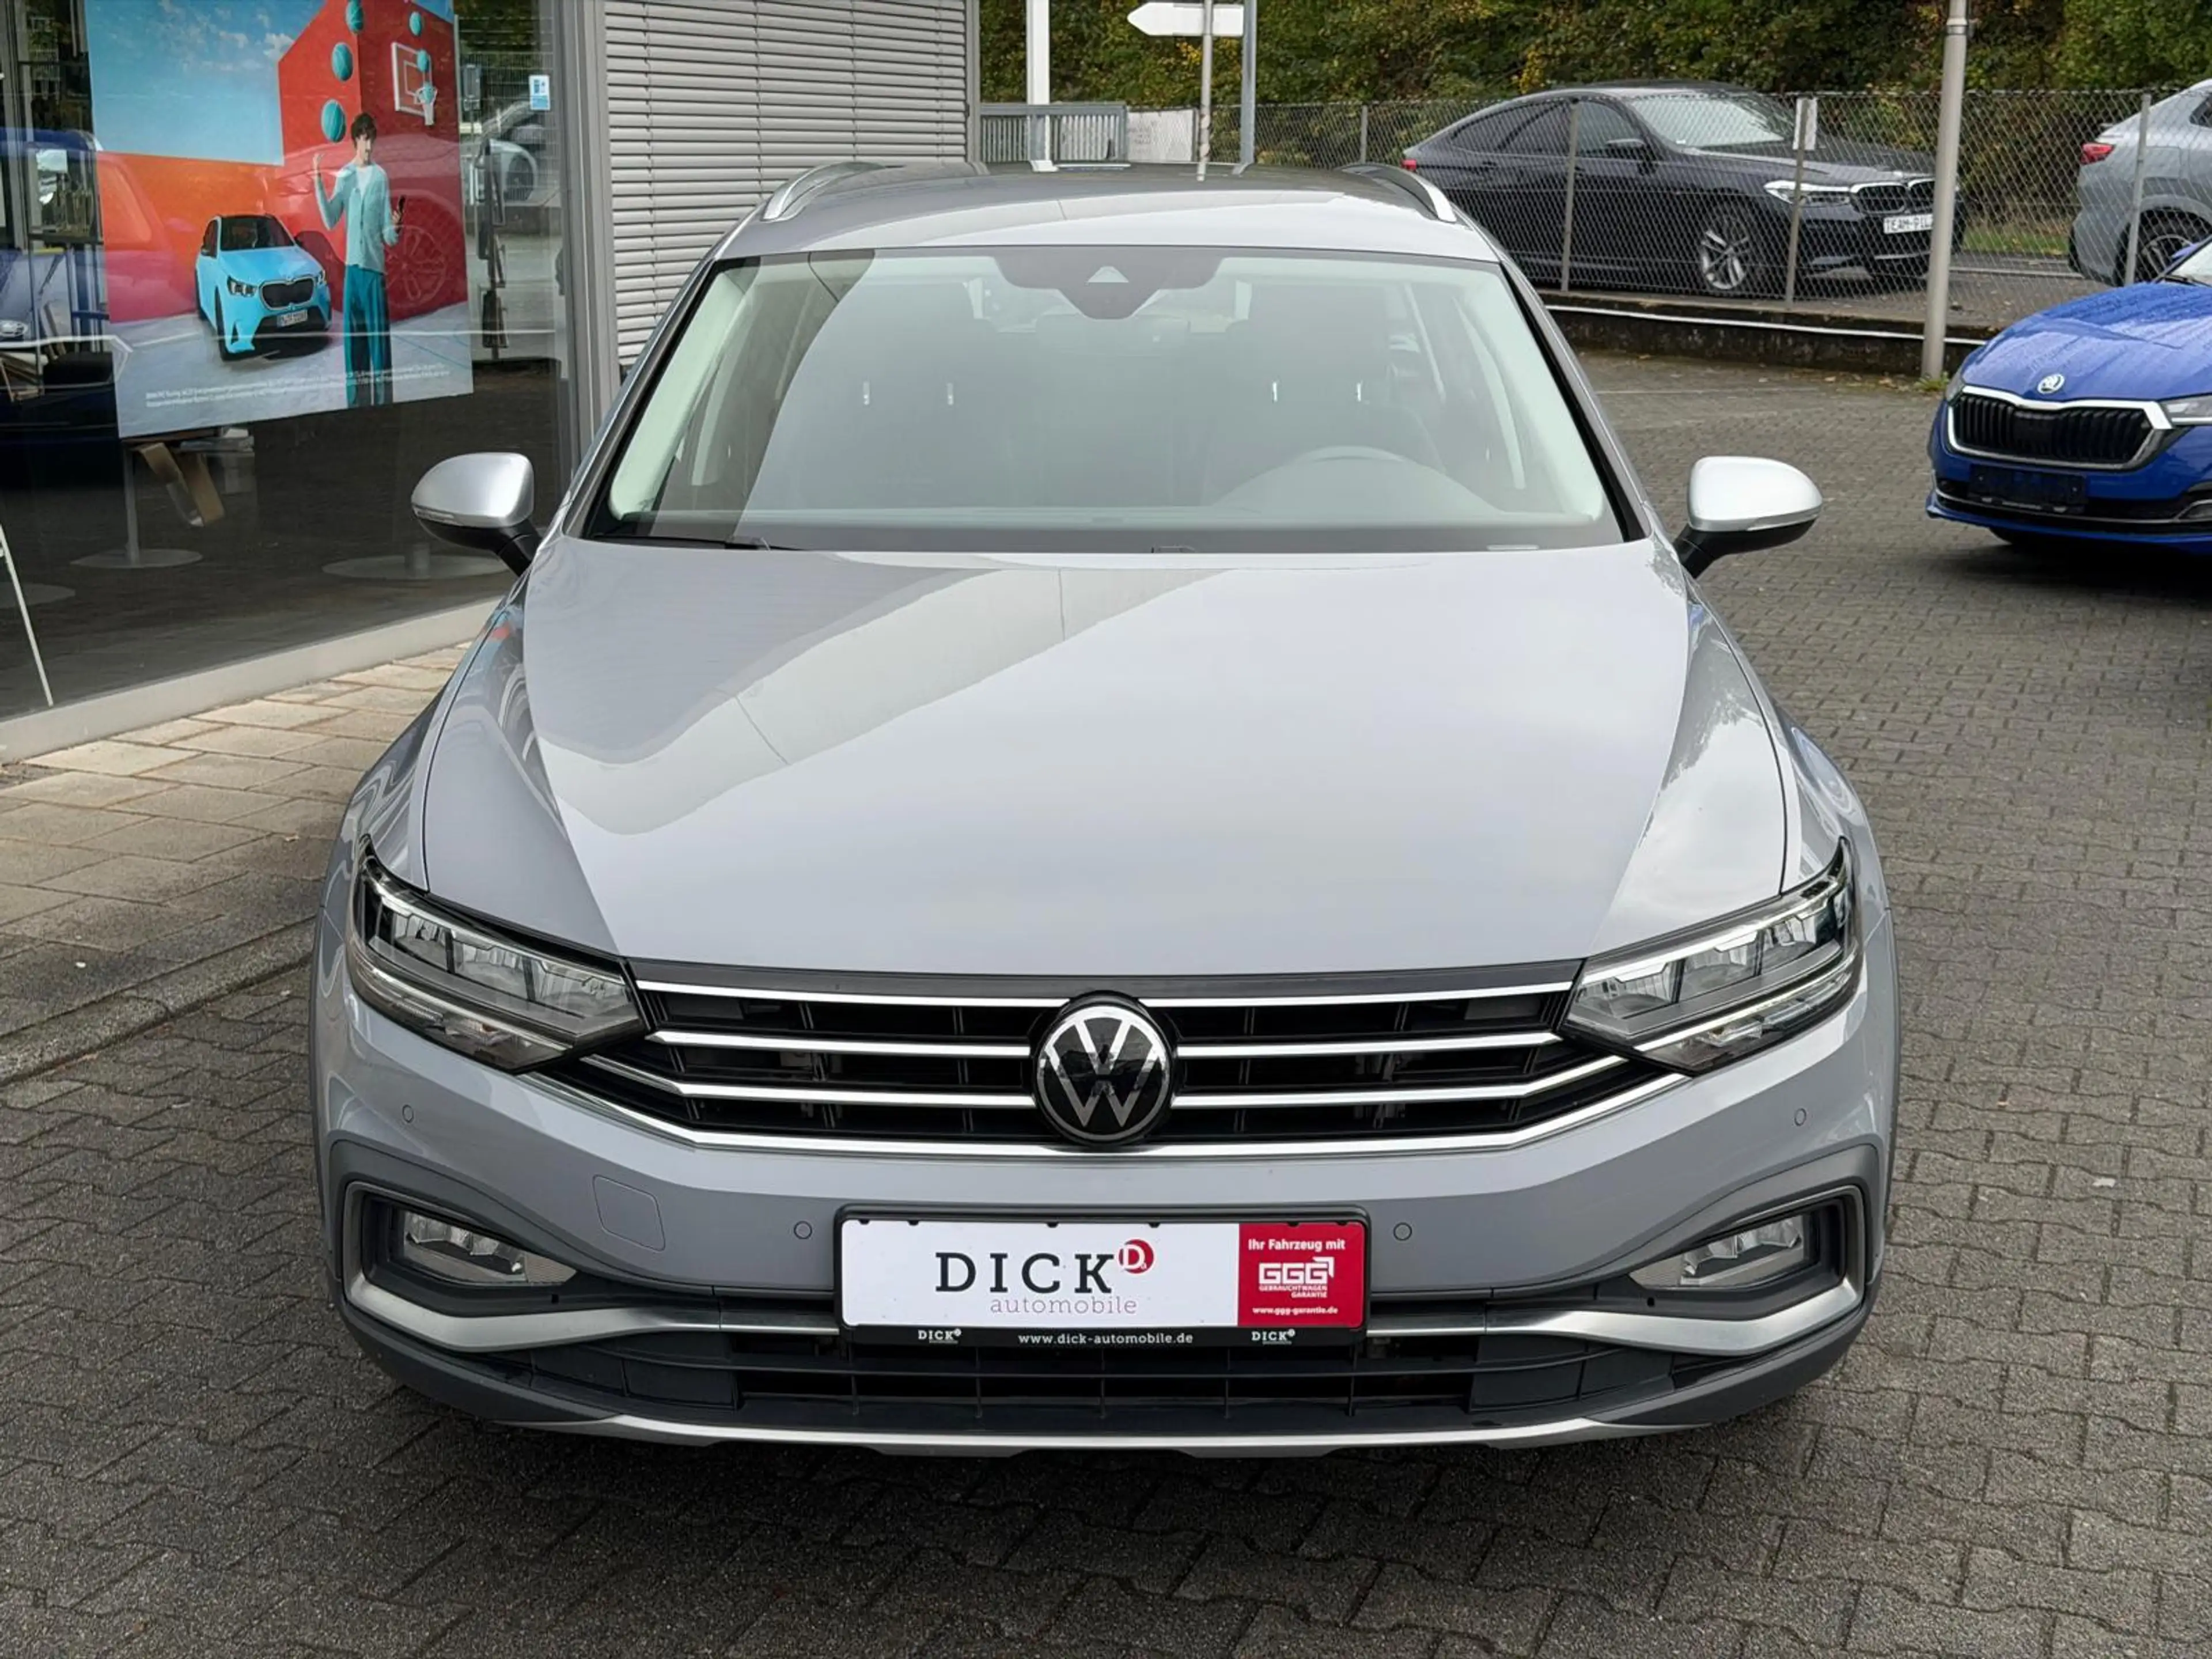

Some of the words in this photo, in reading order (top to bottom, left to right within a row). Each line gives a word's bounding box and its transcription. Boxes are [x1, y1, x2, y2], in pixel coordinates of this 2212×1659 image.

[1248, 1239, 1265, 1251] Ihr
[1268, 1239, 1323, 1252] Fahrzeug
[1325, 1238, 1346, 1251] mit
[935, 1252, 1114, 1293] DICK
[1259, 1262, 1328, 1284] GGG
[990, 1296, 1137, 1315] automobile
[1252, 1306, 1339, 1316] www.ggg-garantie.de
[918, 1330, 955, 1340] DICK
[1018, 1333, 1194, 1344] www.dick-automobile.de
[1251, 1330, 1287, 1342] DICK
